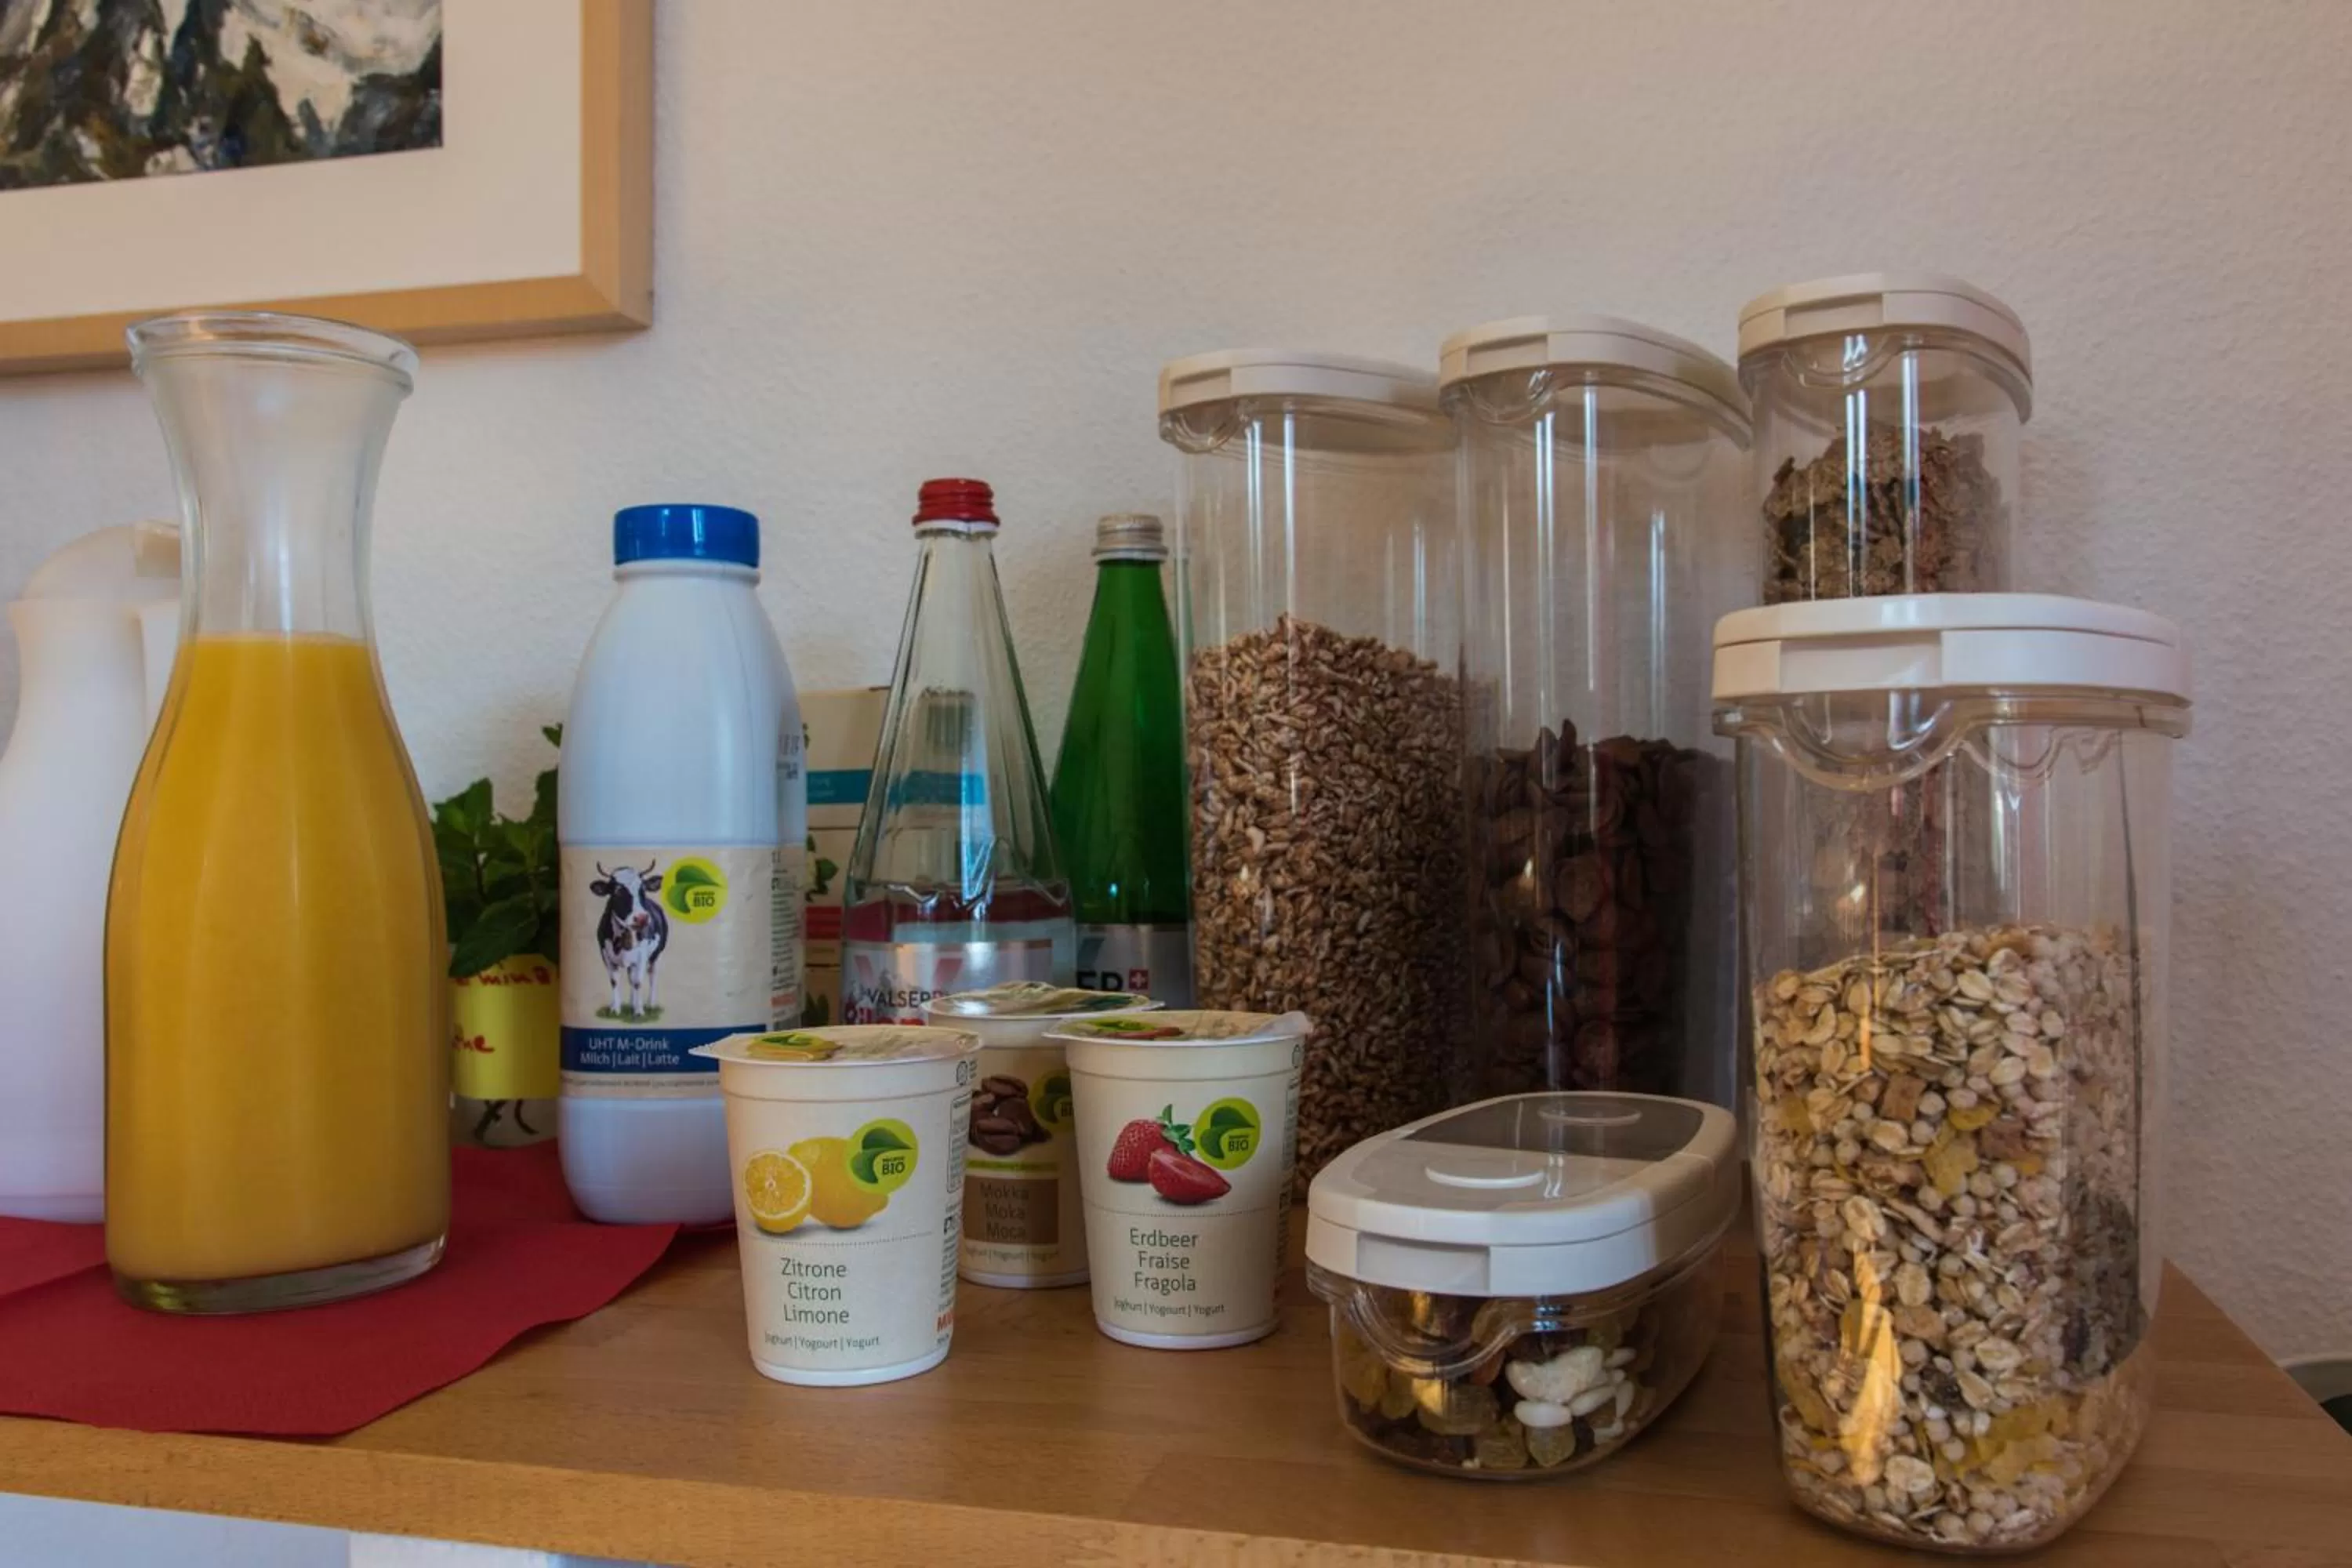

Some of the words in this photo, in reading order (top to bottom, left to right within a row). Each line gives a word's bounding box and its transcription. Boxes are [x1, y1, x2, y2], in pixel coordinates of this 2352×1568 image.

[693, 896, 715, 907] BIO
[589, 1037, 614, 1051] UHT
[617, 1037, 670, 1051] M-Drink
[580, 1052, 610, 1065] Milch
[617, 1053, 640, 1065] Lait
[648, 1054, 680, 1065] Latte
[1228, 1140, 1248, 1152] BIO
[882, 1160, 906, 1174] BIO
[1130, 1228, 1199, 1247] Erdbeer
[781, 1256, 847, 1278] Zitrone
[1138, 1250, 1190, 1269] Fraise
[787, 1281, 841, 1301] Citron
[1134, 1271, 1196, 1296] Fragola
[784, 1304, 850, 1324] Limone
[846, 1335, 879, 1349] Yogurt
